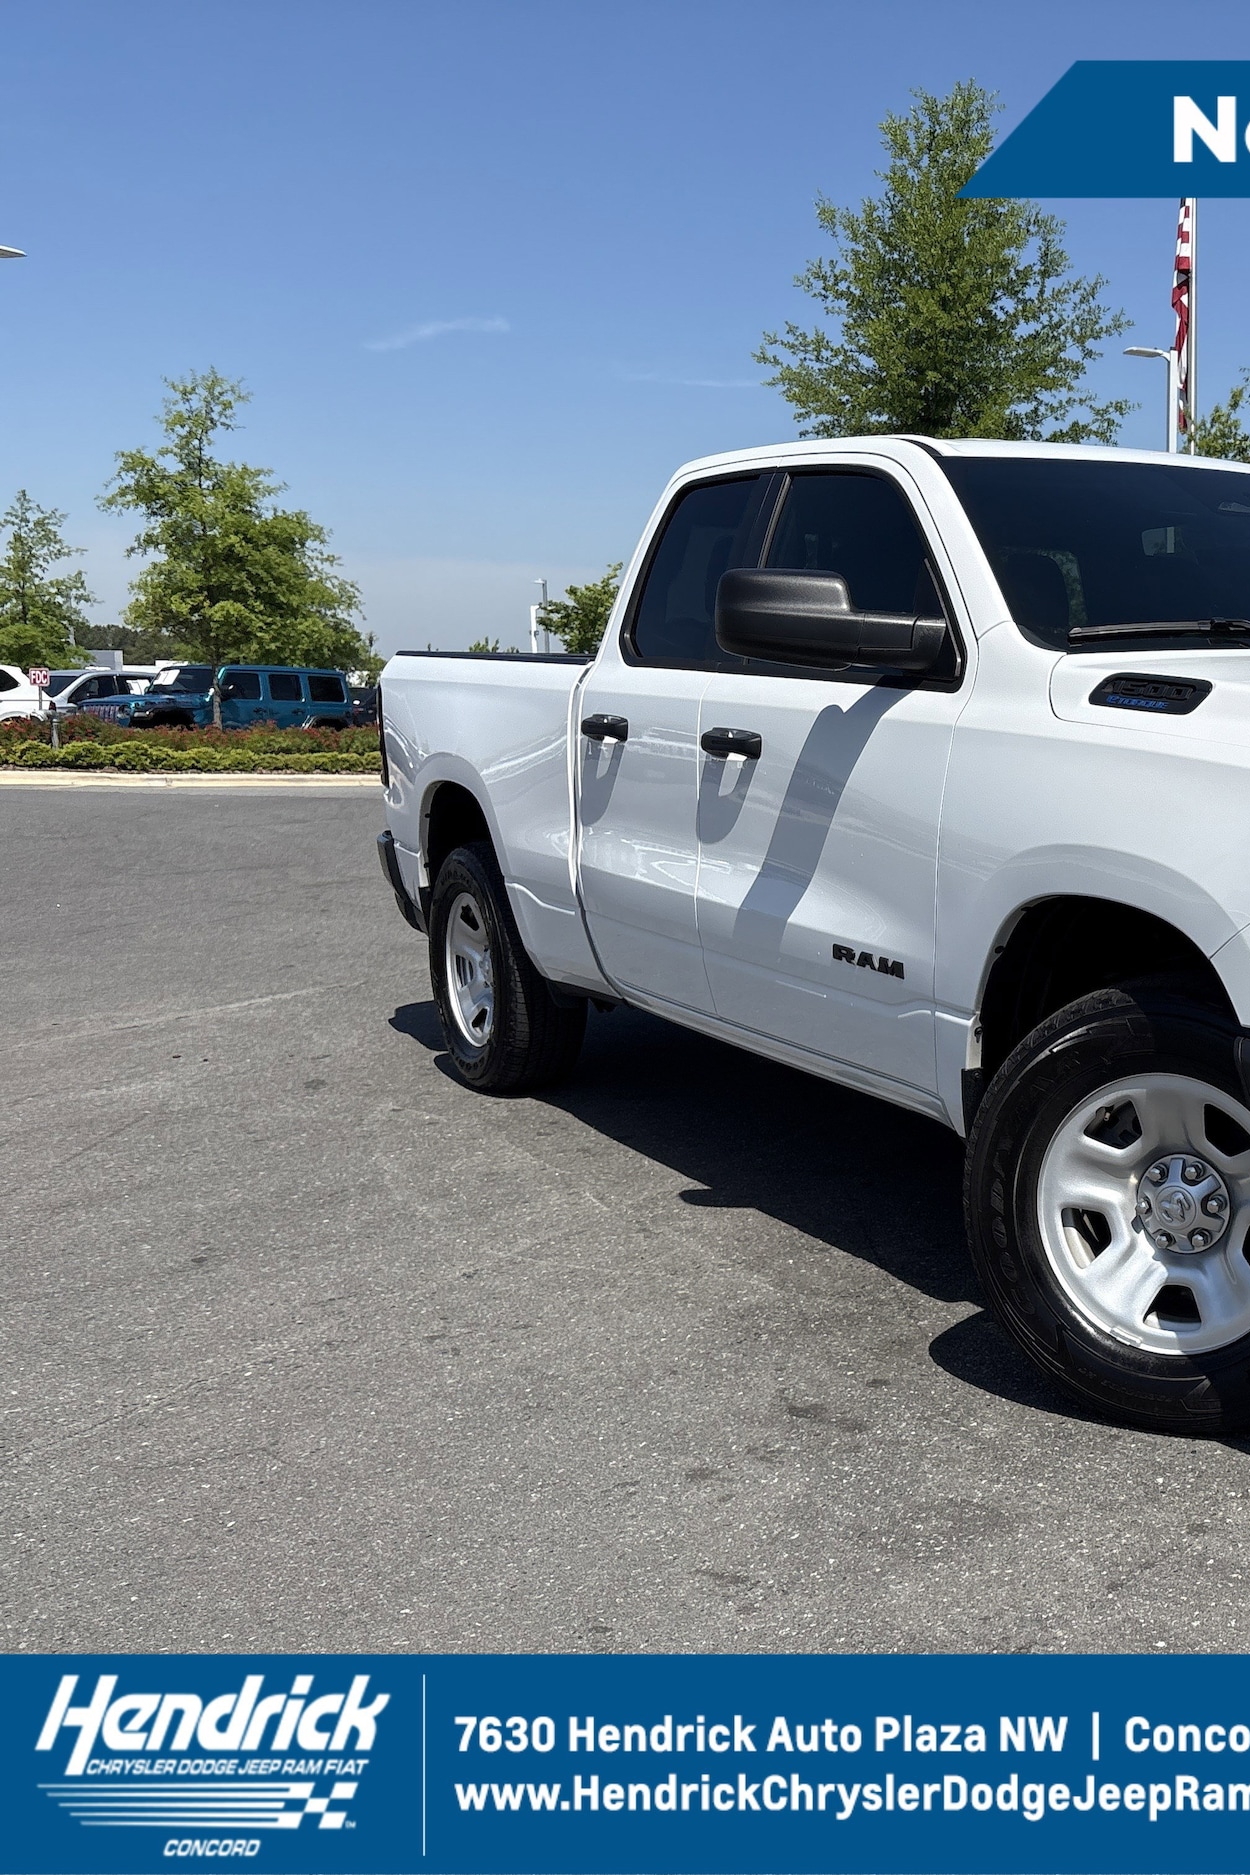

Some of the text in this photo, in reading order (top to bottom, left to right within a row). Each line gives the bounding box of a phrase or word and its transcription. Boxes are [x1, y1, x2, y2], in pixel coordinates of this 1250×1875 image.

[31, 671, 48, 684] FDC
[1112, 678, 1194, 700] 1500
[832, 943, 905, 980] RAM
